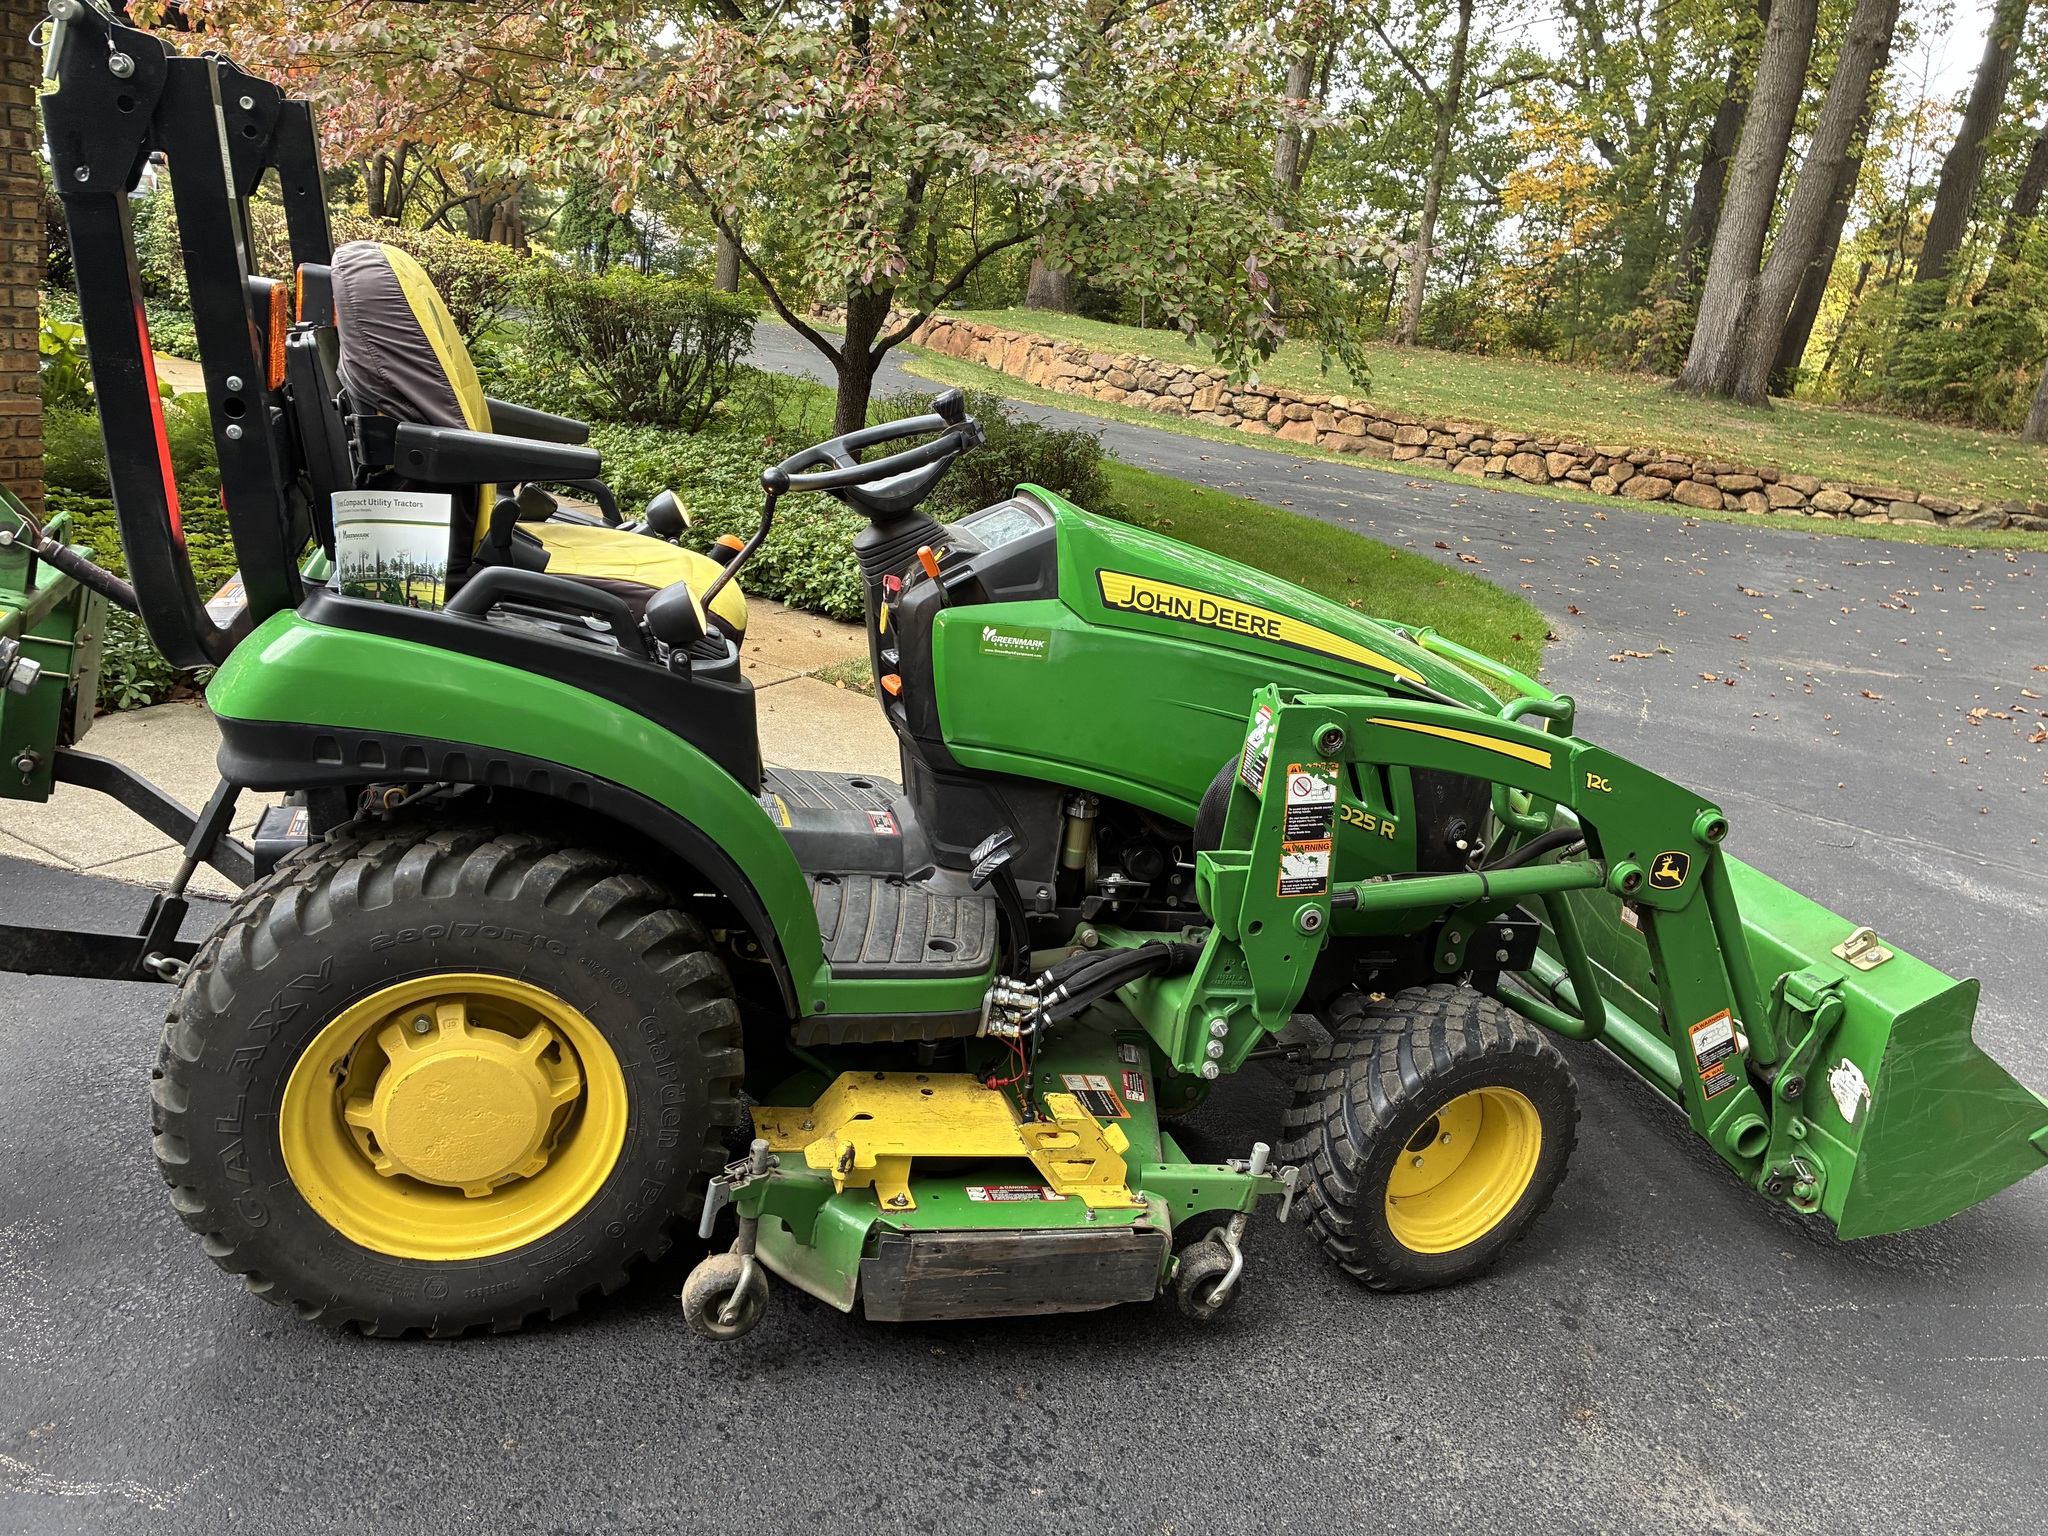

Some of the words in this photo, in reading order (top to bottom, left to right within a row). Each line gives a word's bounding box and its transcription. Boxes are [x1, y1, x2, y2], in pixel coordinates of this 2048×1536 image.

[368, 498, 392, 508] Utility
[394, 498, 424, 508] Tractors
[1120, 585, 1192, 617] JOHN
[1199, 600, 1282, 638] DEERE
[991, 636, 1045, 648] GREENMARK
[1340, 804, 1377, 831] 025
[1292, 843, 1330, 852] WARNING
[1699, 1012, 1725, 1029] WARNING
[216, 955, 334, 1228] GALAXY
